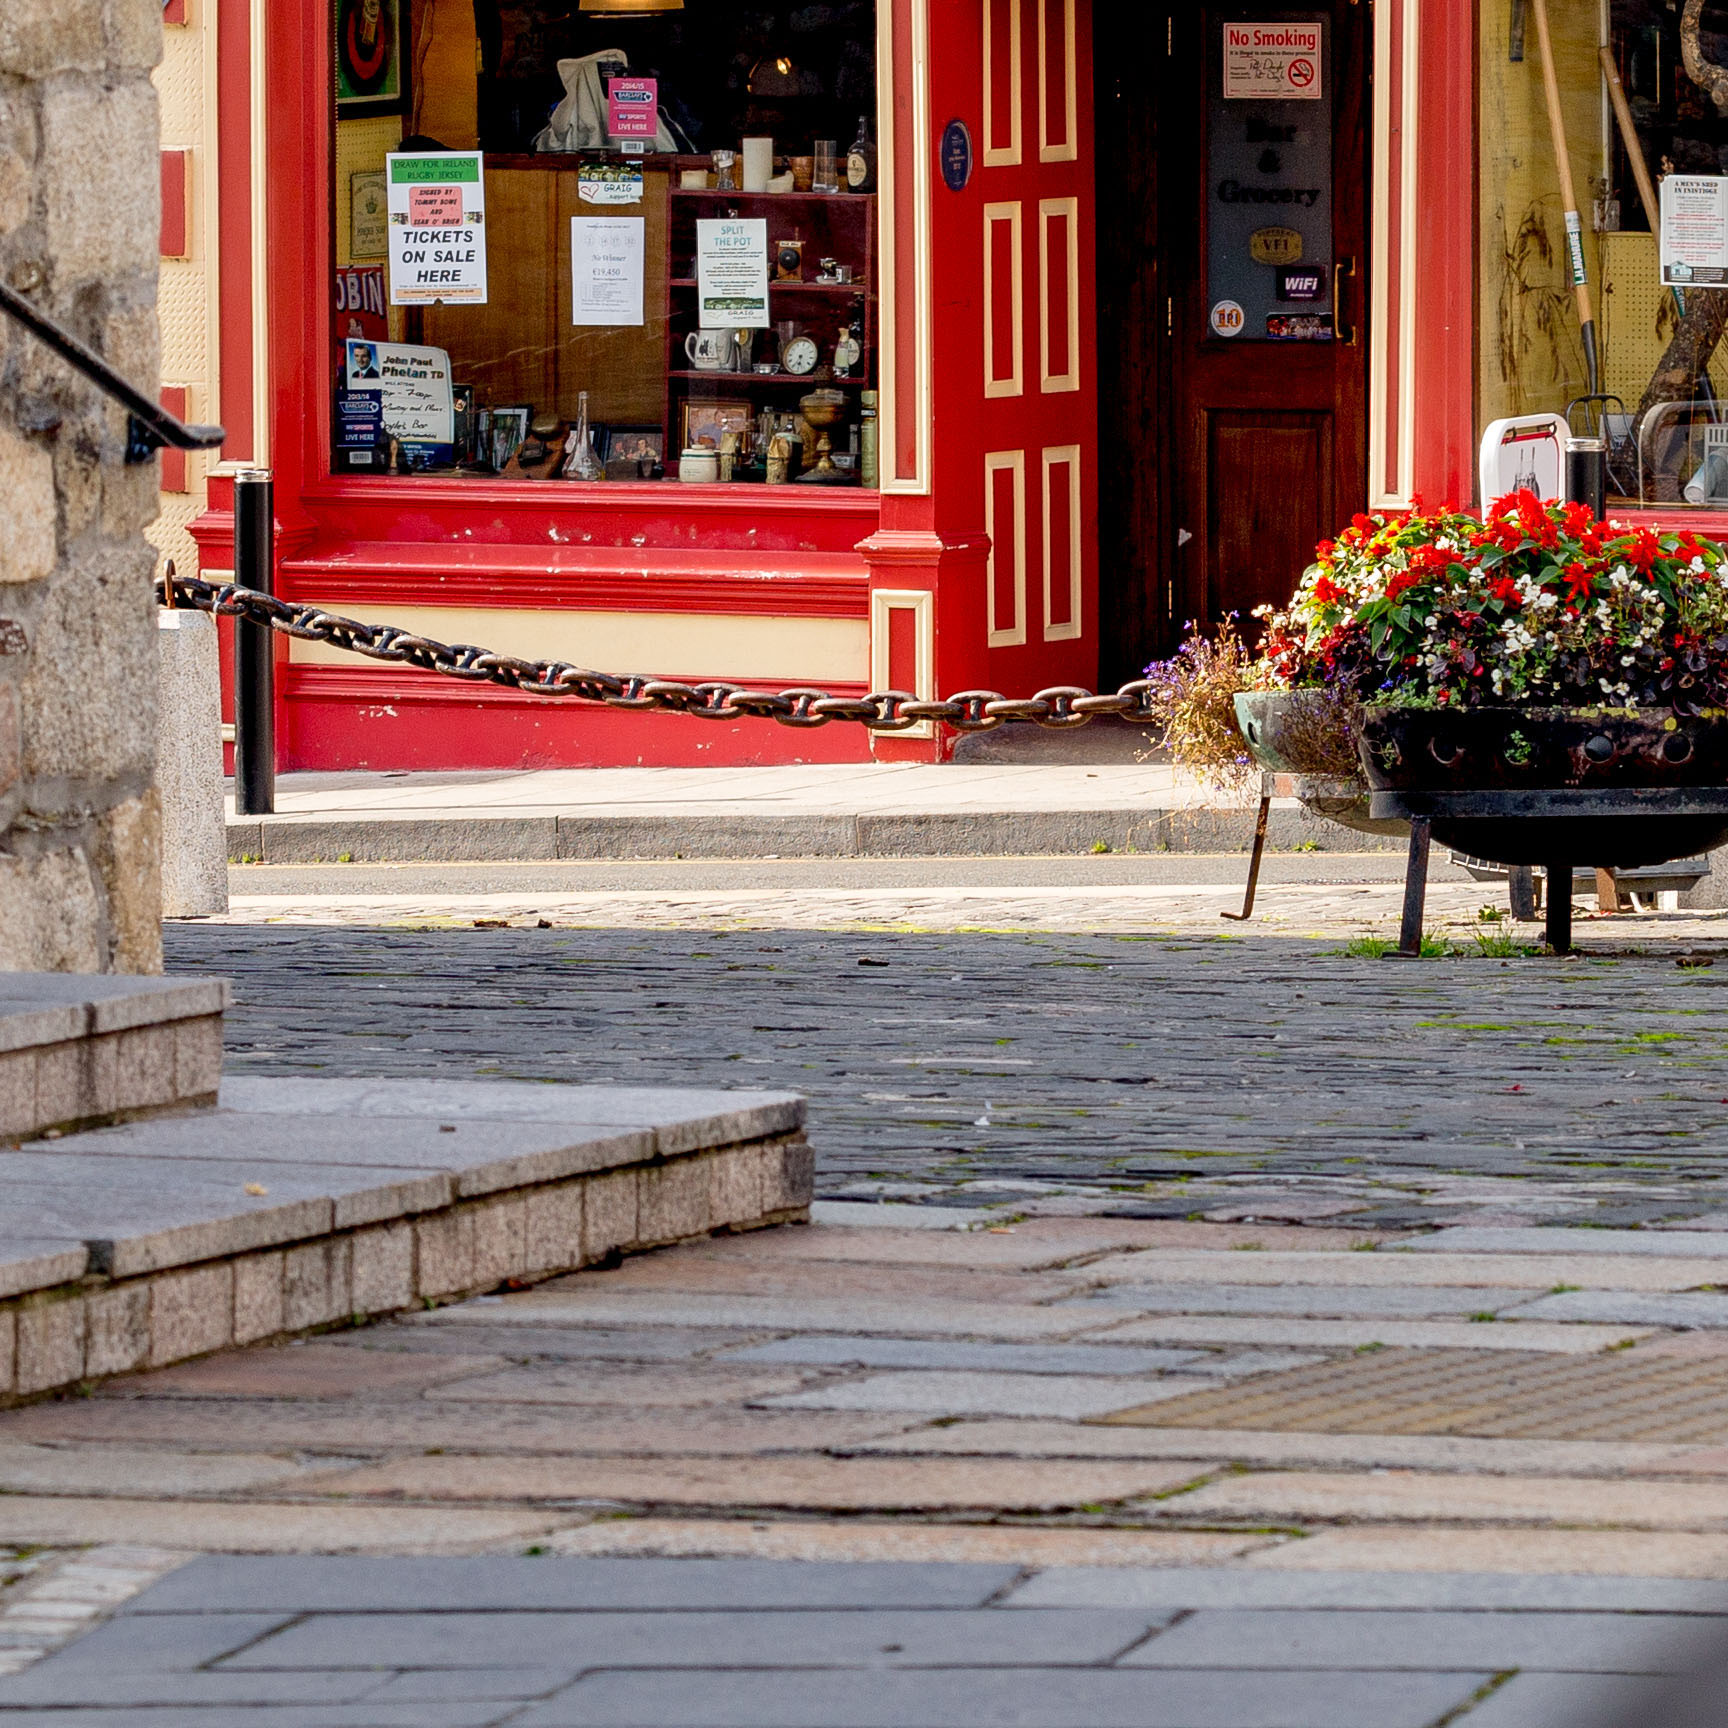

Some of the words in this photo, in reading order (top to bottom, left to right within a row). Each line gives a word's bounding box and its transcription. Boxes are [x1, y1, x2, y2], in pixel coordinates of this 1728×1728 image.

[1230, 29, 1249, 46] No
[1253, 28, 1316, 50] Smoking
[394, 160, 418, 169] DRAW
[423, 160, 439, 168] FOR
[442, 160, 476, 168] IRELAND
[1217, 179, 1321, 208] Grocery
[403, 230, 474, 244] TICKETS
[721, 226, 744, 235] SPLIT
[714, 237, 732, 246] THE
[733, 237, 752, 246] POT
[402, 250, 426, 264] ON
[433, 250, 476, 262] SALE
[416, 269, 462, 282] HERE
[1285, 277, 1318, 290] WiFi
[383, 356, 408, 366] John
[410, 358, 433, 366] Paul
[382, 366, 428, 379] Phelan
[430, 370, 444, 379] TD
